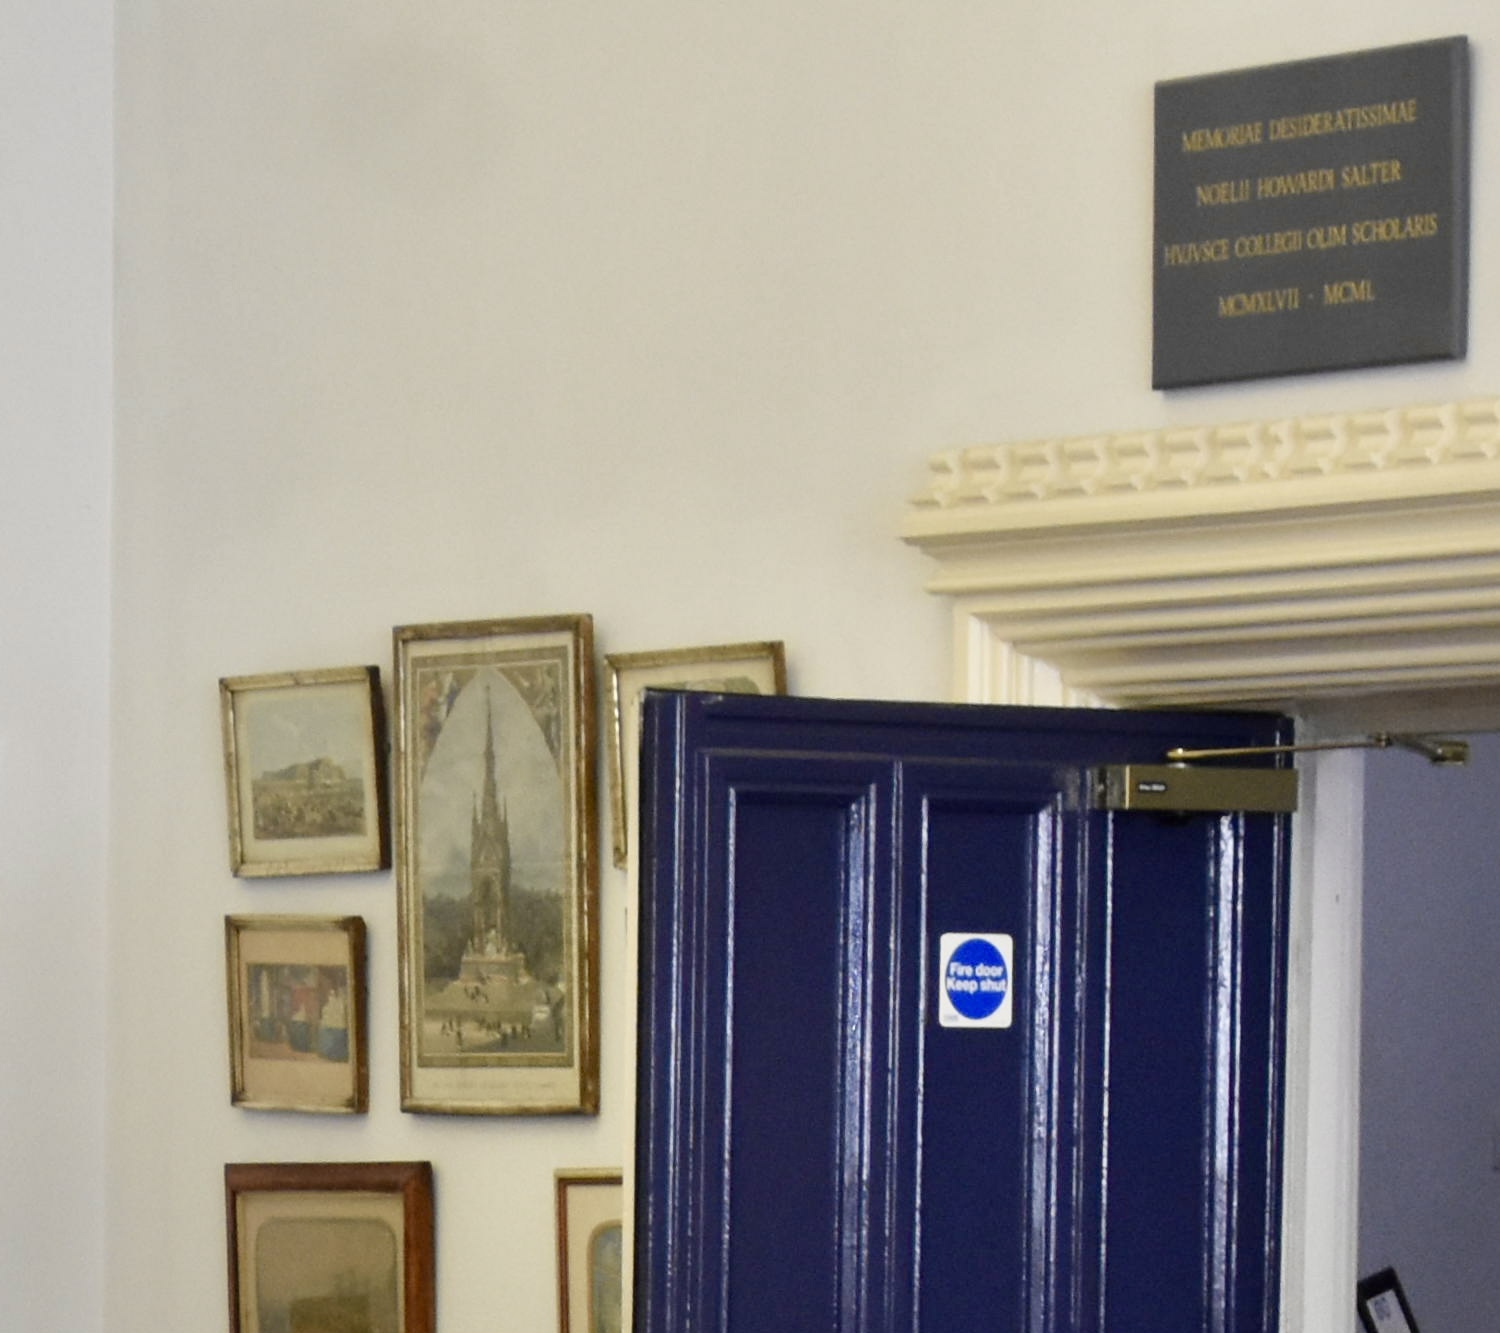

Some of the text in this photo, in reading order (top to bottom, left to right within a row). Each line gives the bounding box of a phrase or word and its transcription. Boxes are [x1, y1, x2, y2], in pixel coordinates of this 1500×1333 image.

[1181, 97, 1418, 152] MEMORIAE DESIDERATISSIMAE
[1257, 167, 1336, 199] HOWARDI
[1341, 159, 1402, 189] SALTER
[1306, 223, 1347, 249] OLIM
[1351, 212, 1439, 244] SCHOLARIS
[946, 977, 1007, 994] Keep shut
[949, 962, 1004, 977] Fire door
